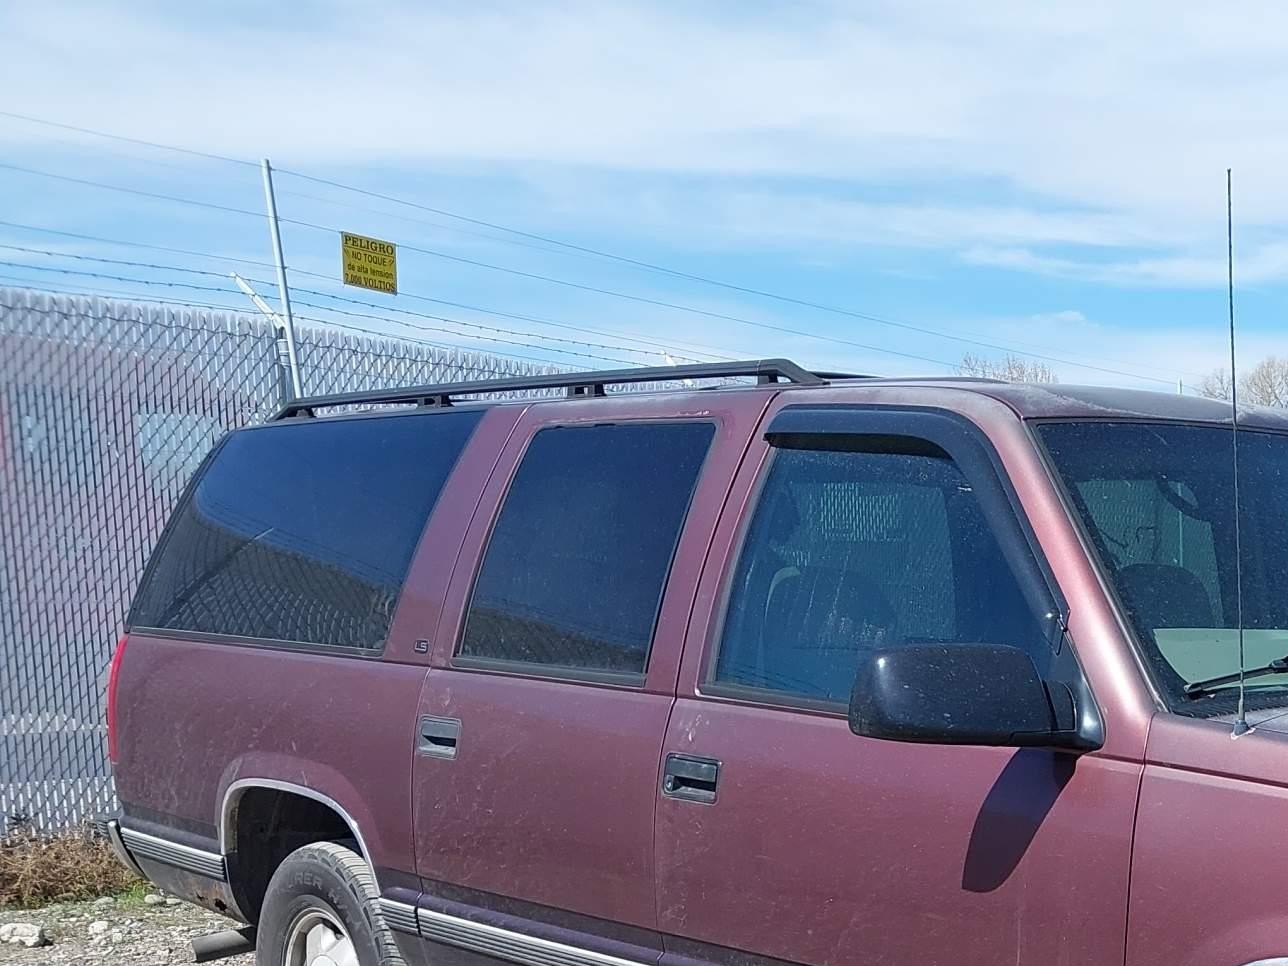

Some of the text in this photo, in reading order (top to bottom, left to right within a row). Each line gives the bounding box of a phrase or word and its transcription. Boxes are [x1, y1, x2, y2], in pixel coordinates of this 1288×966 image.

[344, 235, 394, 255] PELIGRO
[352, 251, 387, 267] NO TOQUE
[347, 263, 355, 272] de
[357, 264, 369, 274] alta
[363, 276, 395, 293] VOLTIOS
